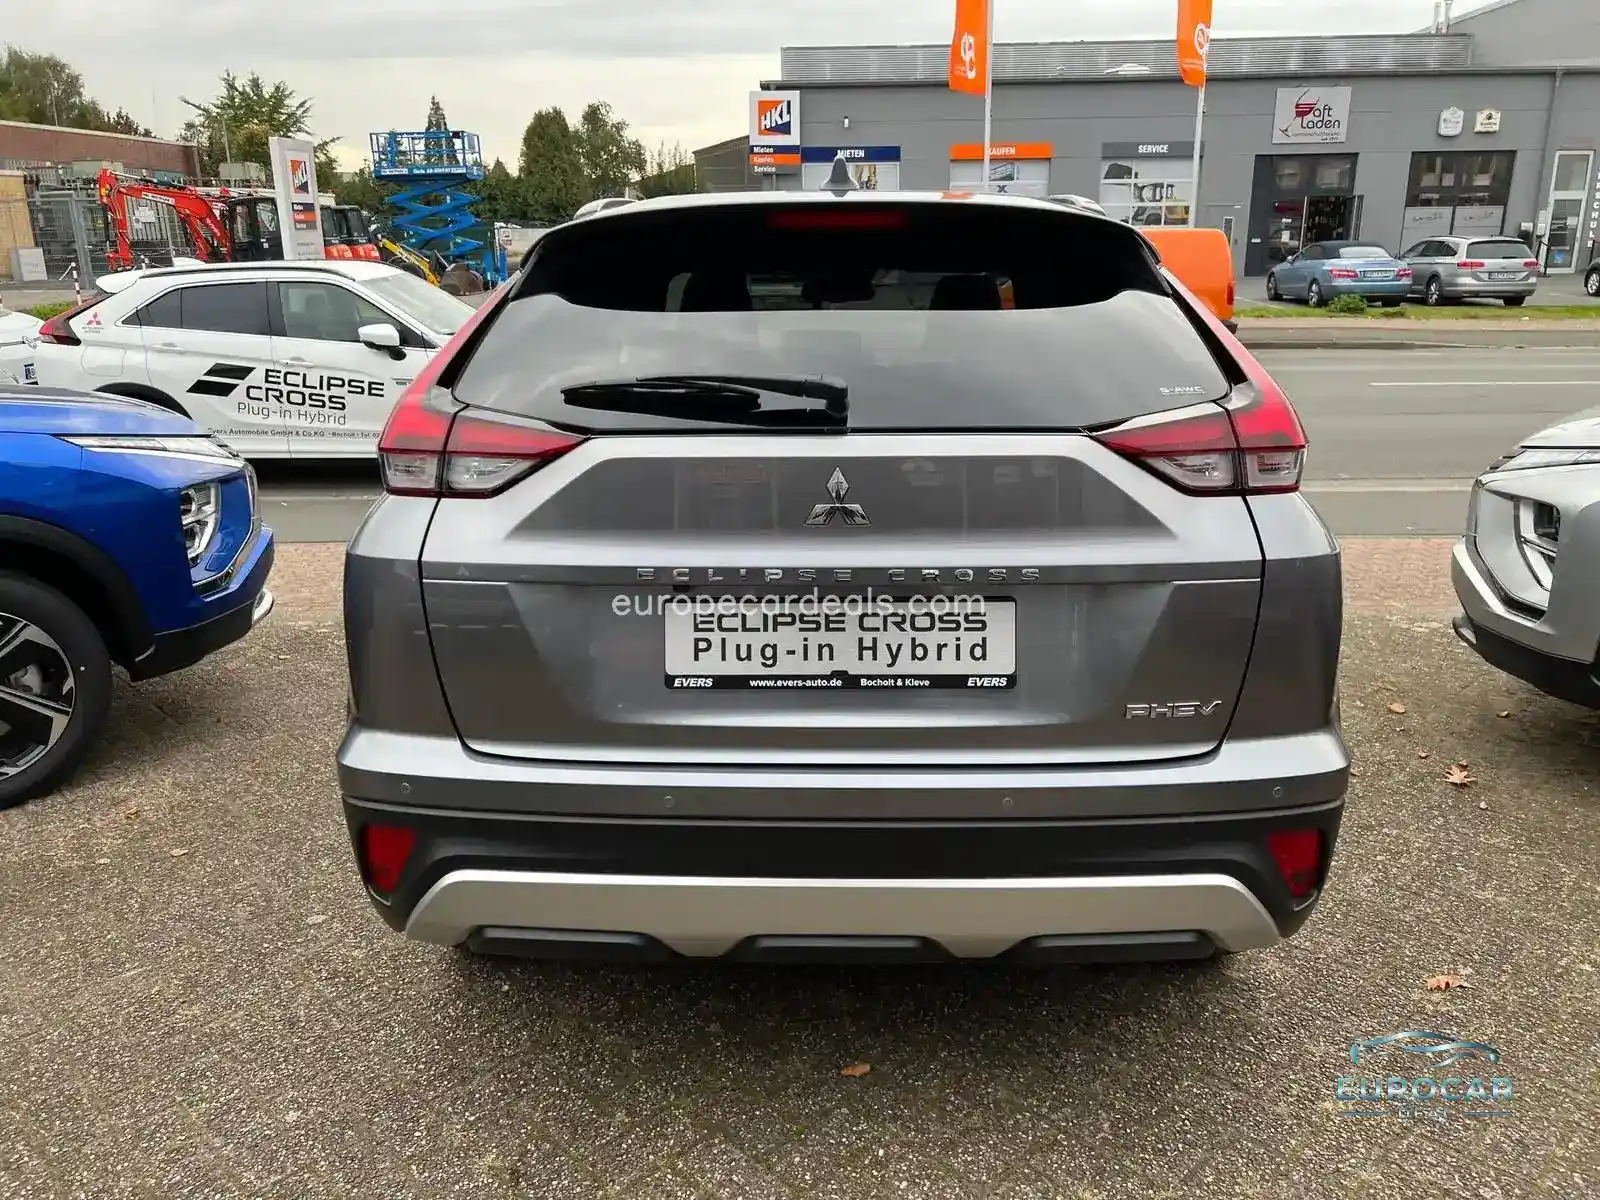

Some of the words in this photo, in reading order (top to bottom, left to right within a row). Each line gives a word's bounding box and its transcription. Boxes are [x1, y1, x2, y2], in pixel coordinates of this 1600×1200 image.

[761, 100, 790, 131] HKL
[837, 149, 865, 158] MIETEN
[987, 146, 1016, 156] KAUFEN
[1138, 144, 1169, 153] SERVICE
[754, 165, 776, 173] Service
[264, 368, 385, 397] ECLIPSE
[245, 385, 347, 411] CROSS
[237, 402, 293, 419] Plug-in
[298, 410, 346, 426] Hybrid
[637, 567, 852, 583] ECLIPSE
[888, 567, 1041, 583] CROSS
[693, 612, 847, 633] ECLIPSE
[858, 612, 988, 633] CROSS
[693, 638, 835, 668] Plug-in
[858, 636, 988, 668] Hybrid
[673, 677, 714, 688] EVERS
[749, 678, 843, 687] www.evers-auto.de
[860, 677, 893, 687] Bocholt
[894, 678, 901, 687] &
[903, 677, 930, 687] Kleve
[967, 676, 1008, 687] EVERS
[1125, 700, 1222, 719] PHEV
